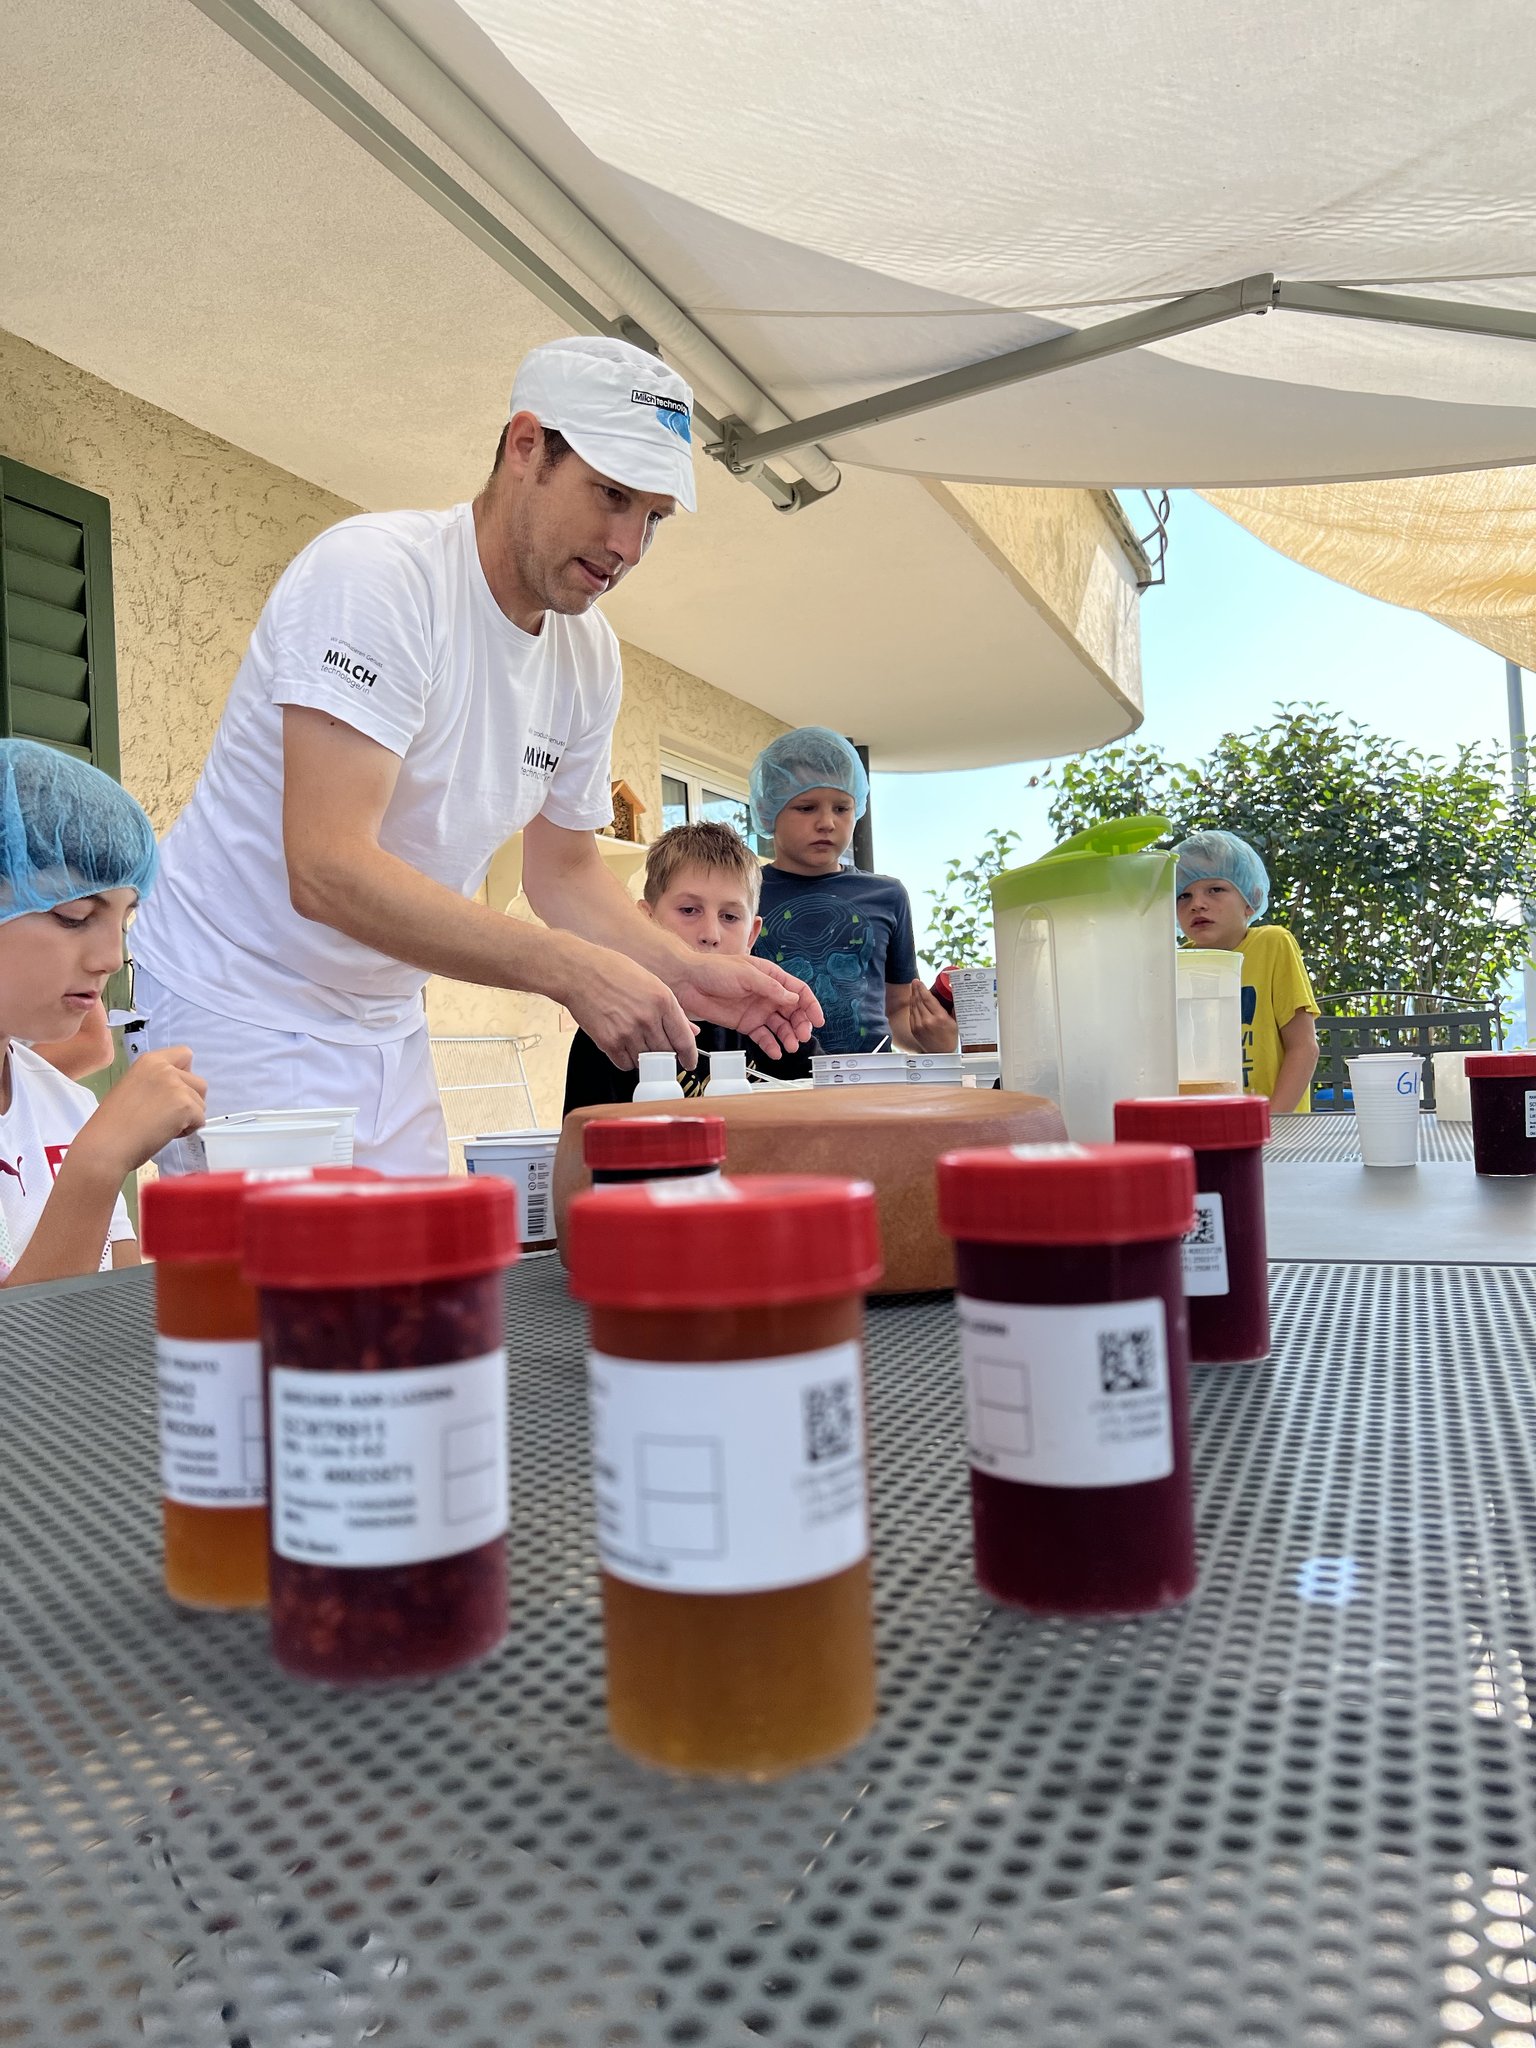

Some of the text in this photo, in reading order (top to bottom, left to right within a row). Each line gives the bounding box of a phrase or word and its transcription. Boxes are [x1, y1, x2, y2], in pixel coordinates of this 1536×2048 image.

[634, 391, 656, 405] Milch
[320, 664, 370, 695] technologe/in
[323, 649, 378, 688] MILCH
